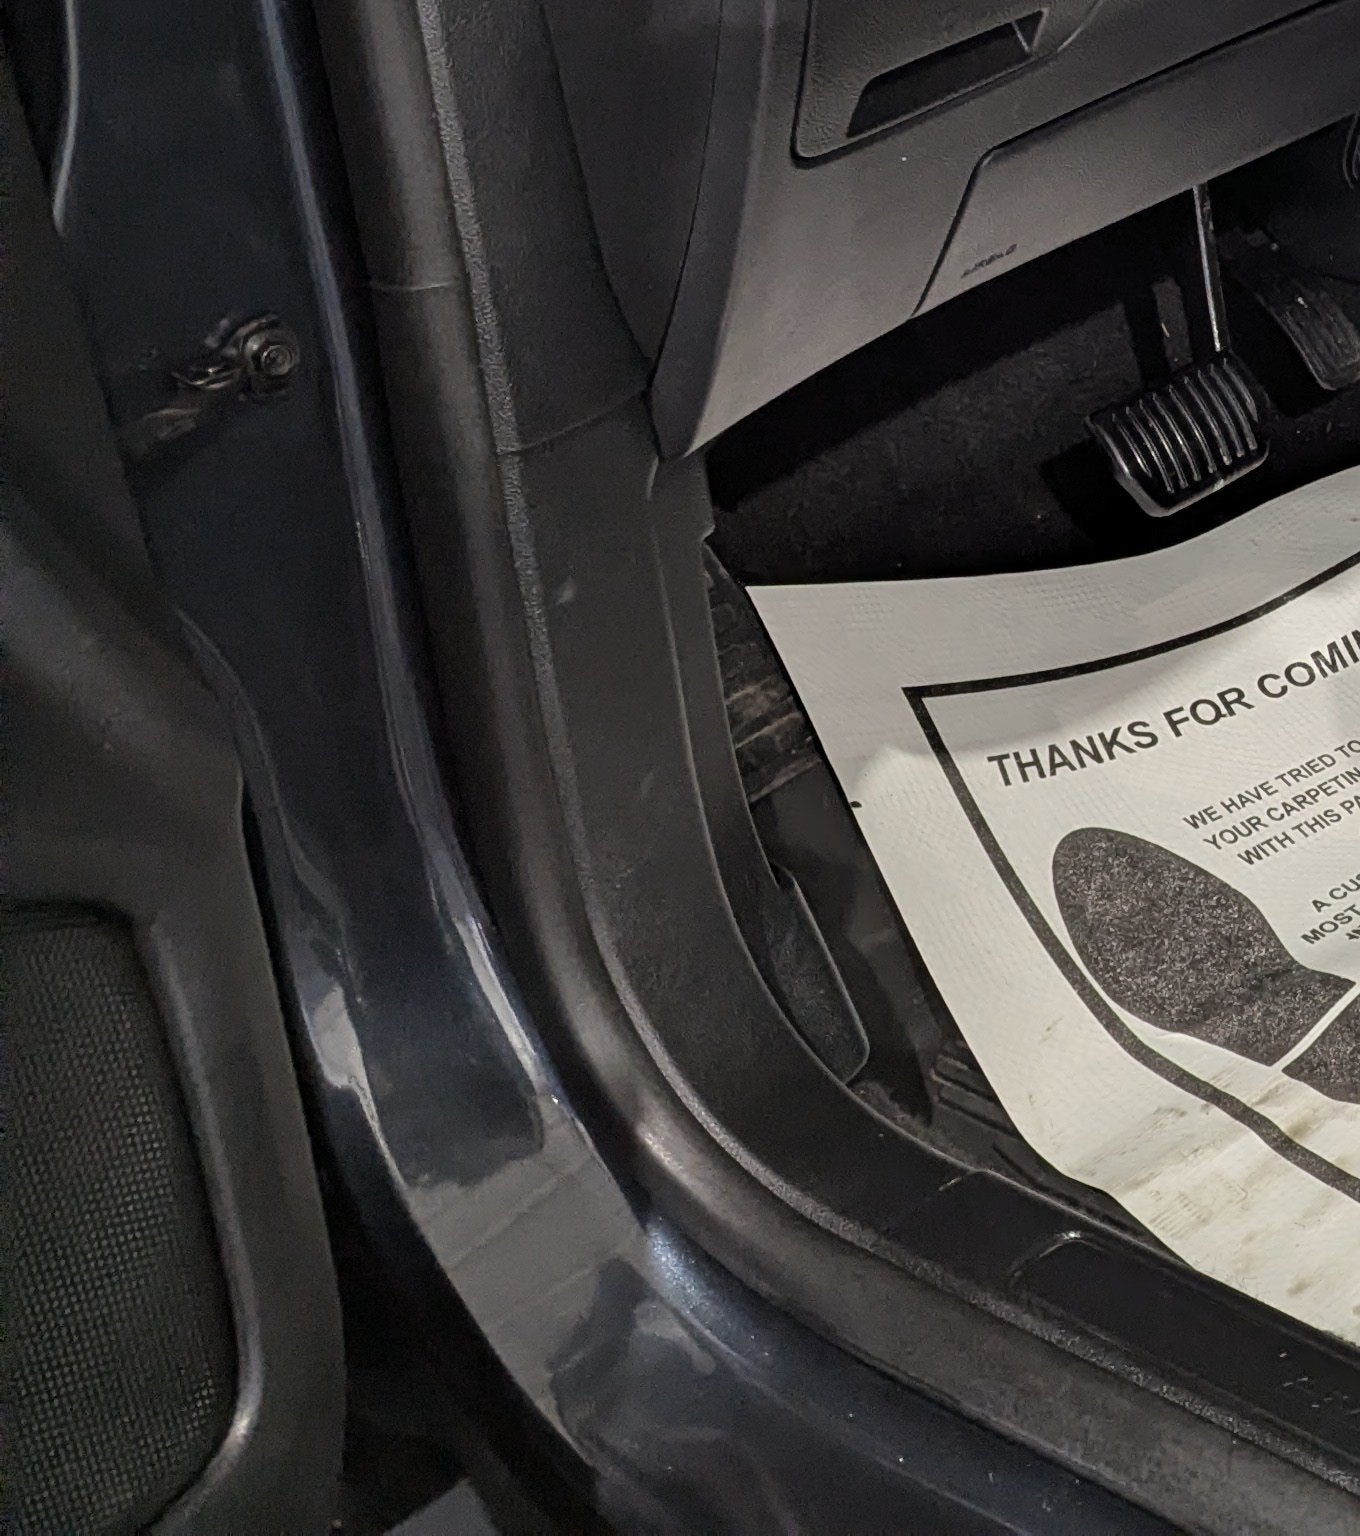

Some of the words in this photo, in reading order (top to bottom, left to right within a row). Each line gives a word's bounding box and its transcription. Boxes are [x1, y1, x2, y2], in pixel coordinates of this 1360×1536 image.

[987, 719, 1159, 786] THANKS
[1163, 686, 1255, 737] FOR
[1182, 805, 1223, 830] WE
[1220, 780, 1279, 814] HAVE
[1275, 753, 1337, 789] TRIED
[1202, 815, 1268, 852] YOUR
[1237, 832, 1296, 865] WITH
[1292, 808, 1342, 839] THIS
[1311, 899, 1331, 913] A
